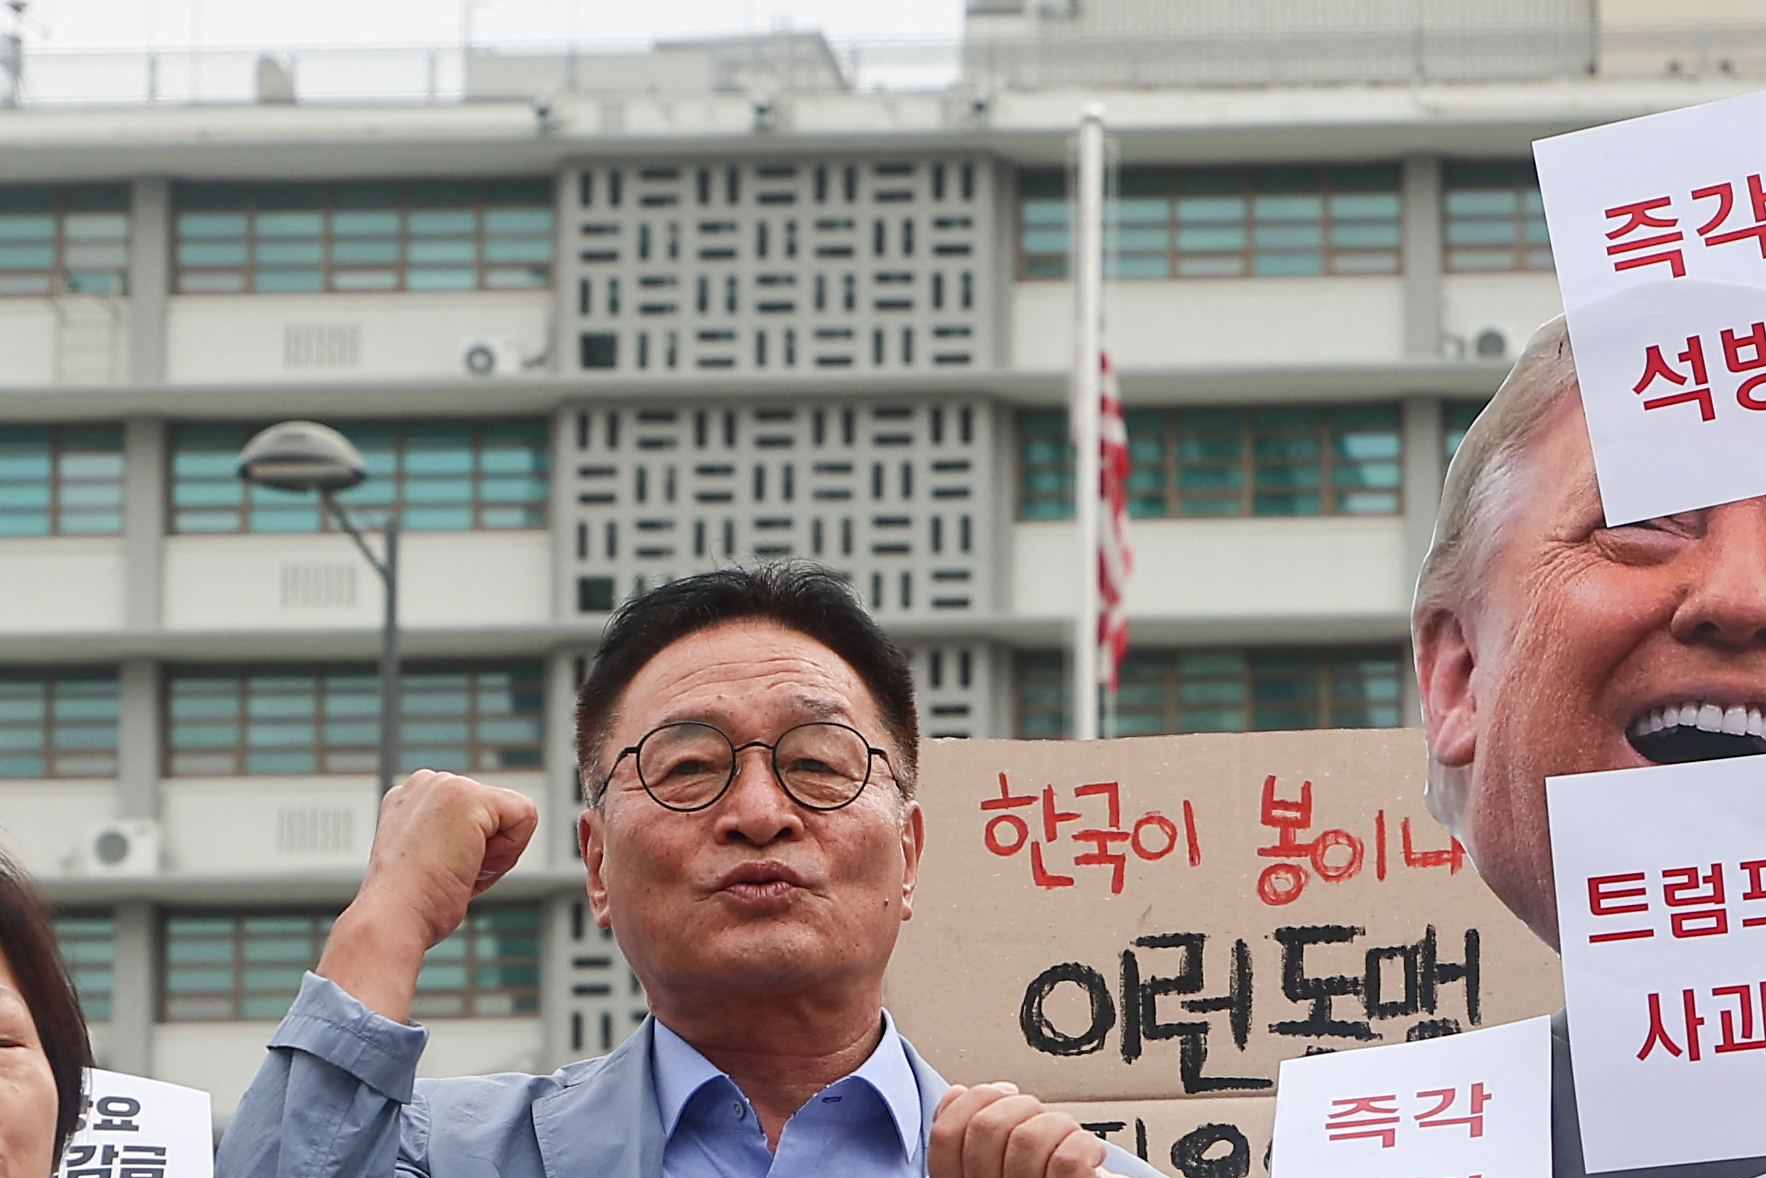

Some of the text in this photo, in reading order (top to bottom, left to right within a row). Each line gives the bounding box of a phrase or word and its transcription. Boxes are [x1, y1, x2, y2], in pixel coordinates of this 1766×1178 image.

[981, 773, 1200, 896] 한국이
[1019, 932, 1274, 1095] 이런
[76, 1094, 141, 1132] 요
[1325, 1082, 1493, 1148] 즉각
